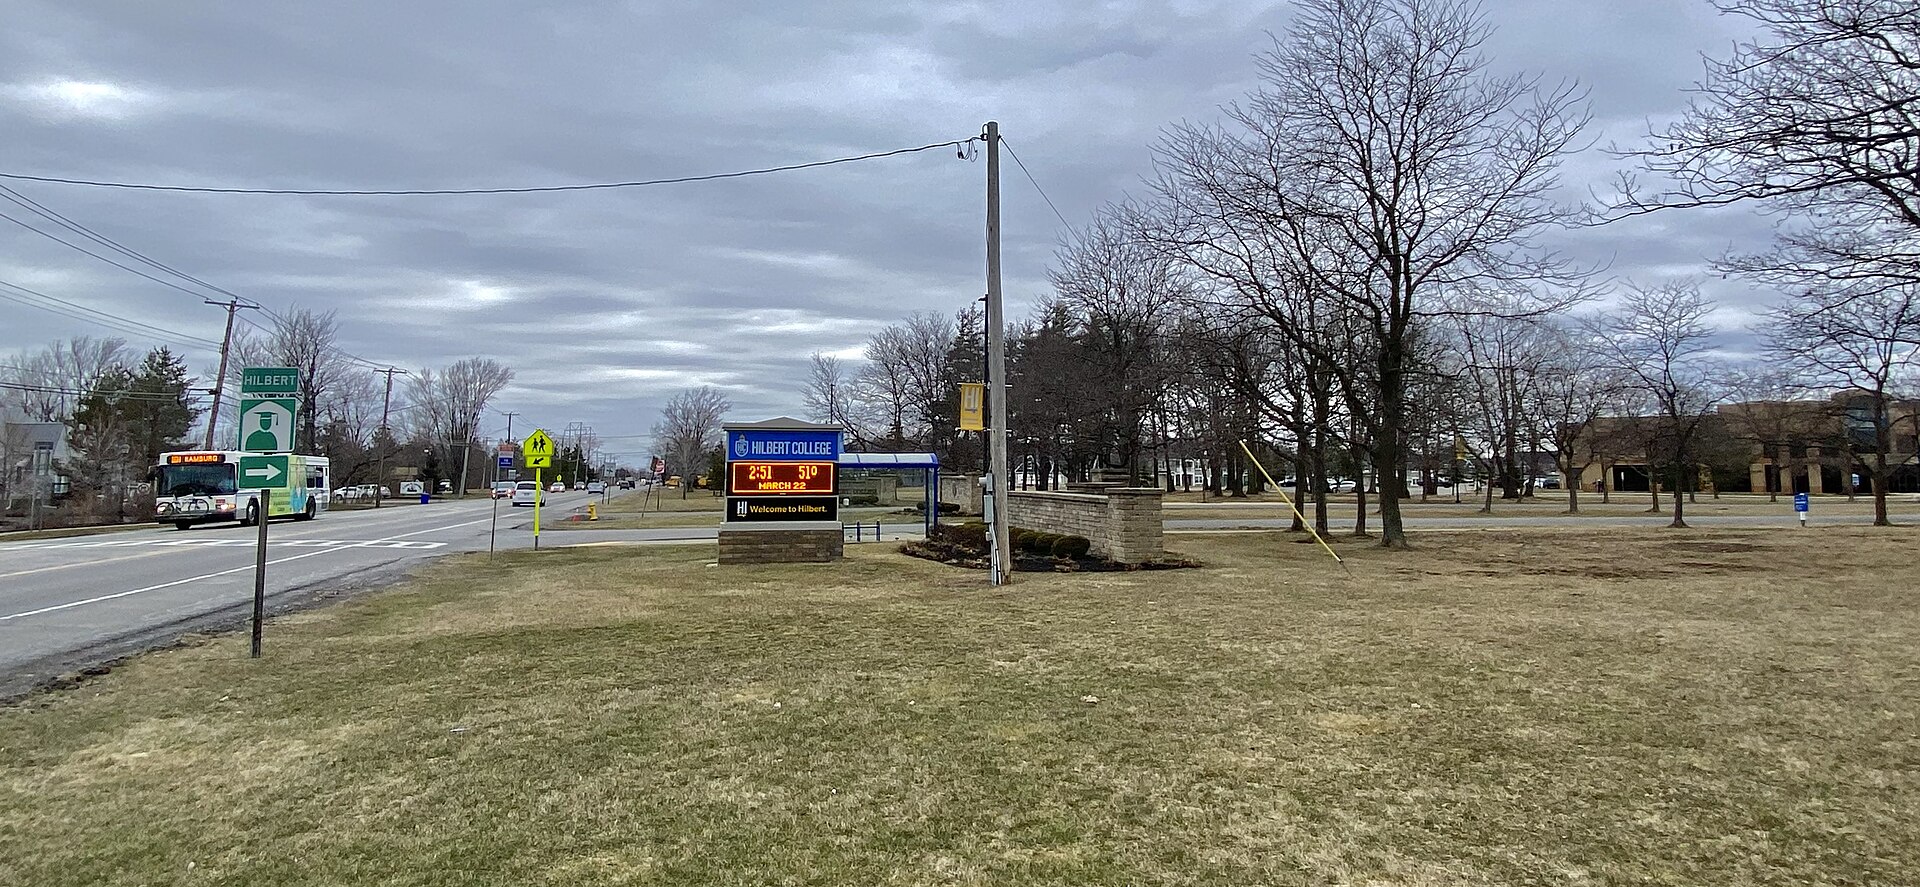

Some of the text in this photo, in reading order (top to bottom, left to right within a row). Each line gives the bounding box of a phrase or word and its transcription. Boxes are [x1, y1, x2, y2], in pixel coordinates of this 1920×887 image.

[244, 375, 296, 386] HILBERT
[751, 441, 832, 455] HILBERT COLLEGE
[749, 465, 772, 480] 2:51
[759, 482, 807, 490] MARCH 22
[749, 504, 828, 513] Welcome to Hilbert.
